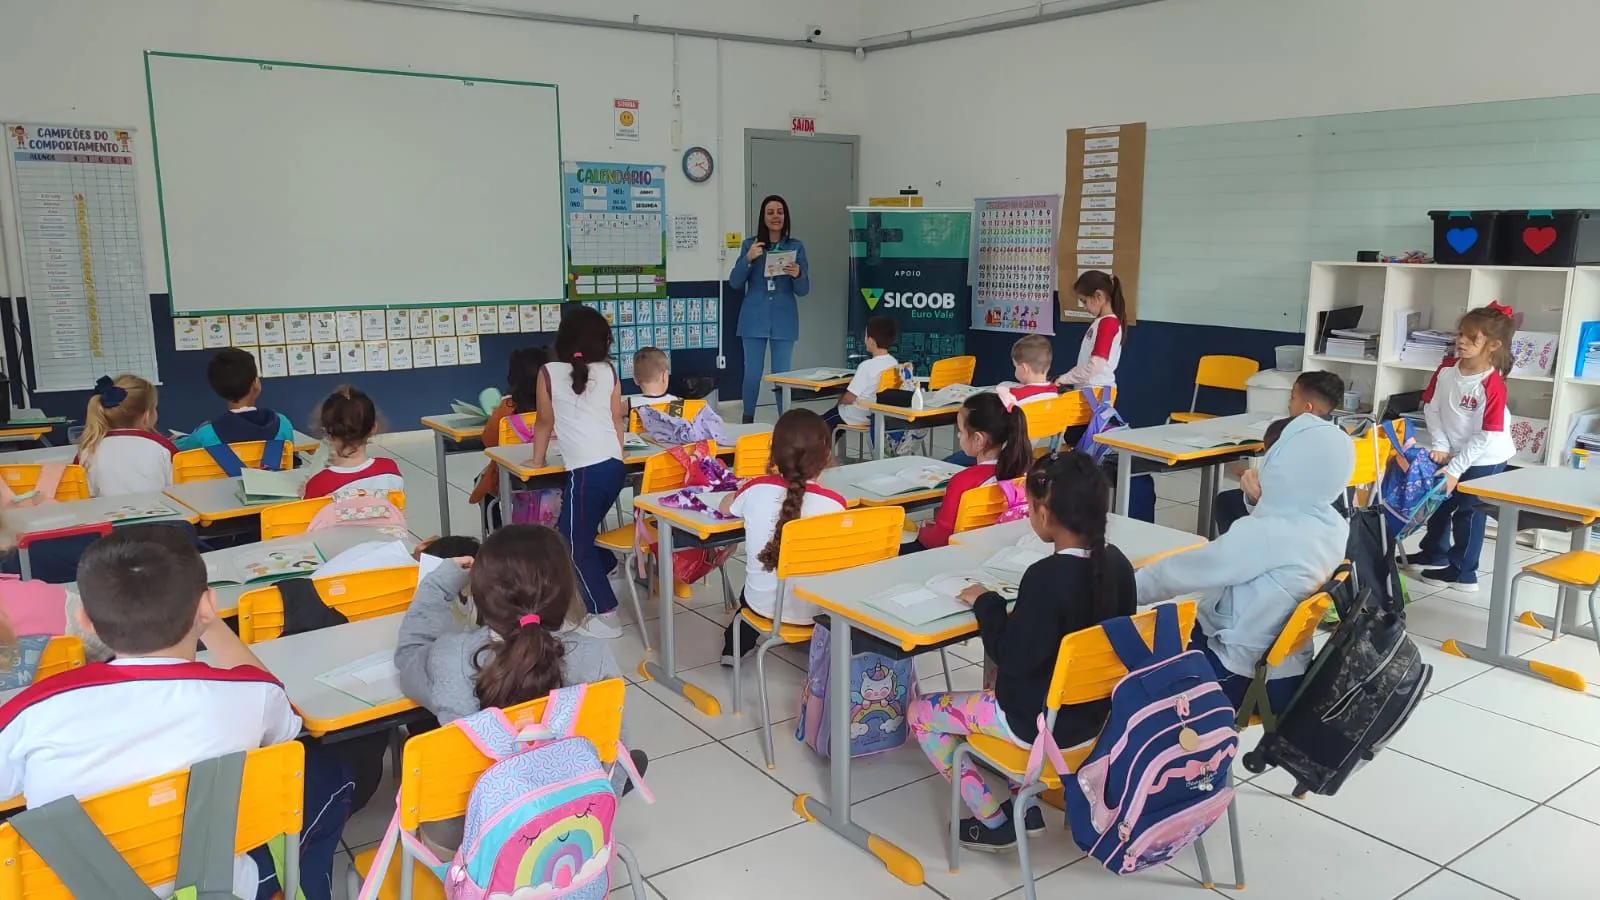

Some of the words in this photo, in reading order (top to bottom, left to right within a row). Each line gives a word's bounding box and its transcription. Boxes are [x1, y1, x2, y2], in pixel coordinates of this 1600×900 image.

[38, 128, 90, 140] CAMPEÕES
[94, 131, 108, 140] DO
[29, 140, 119, 152] COMPORTAMENTO
[577, 166, 651, 185] CALENDÁRIO
[884, 293, 955, 308] SICOOB
